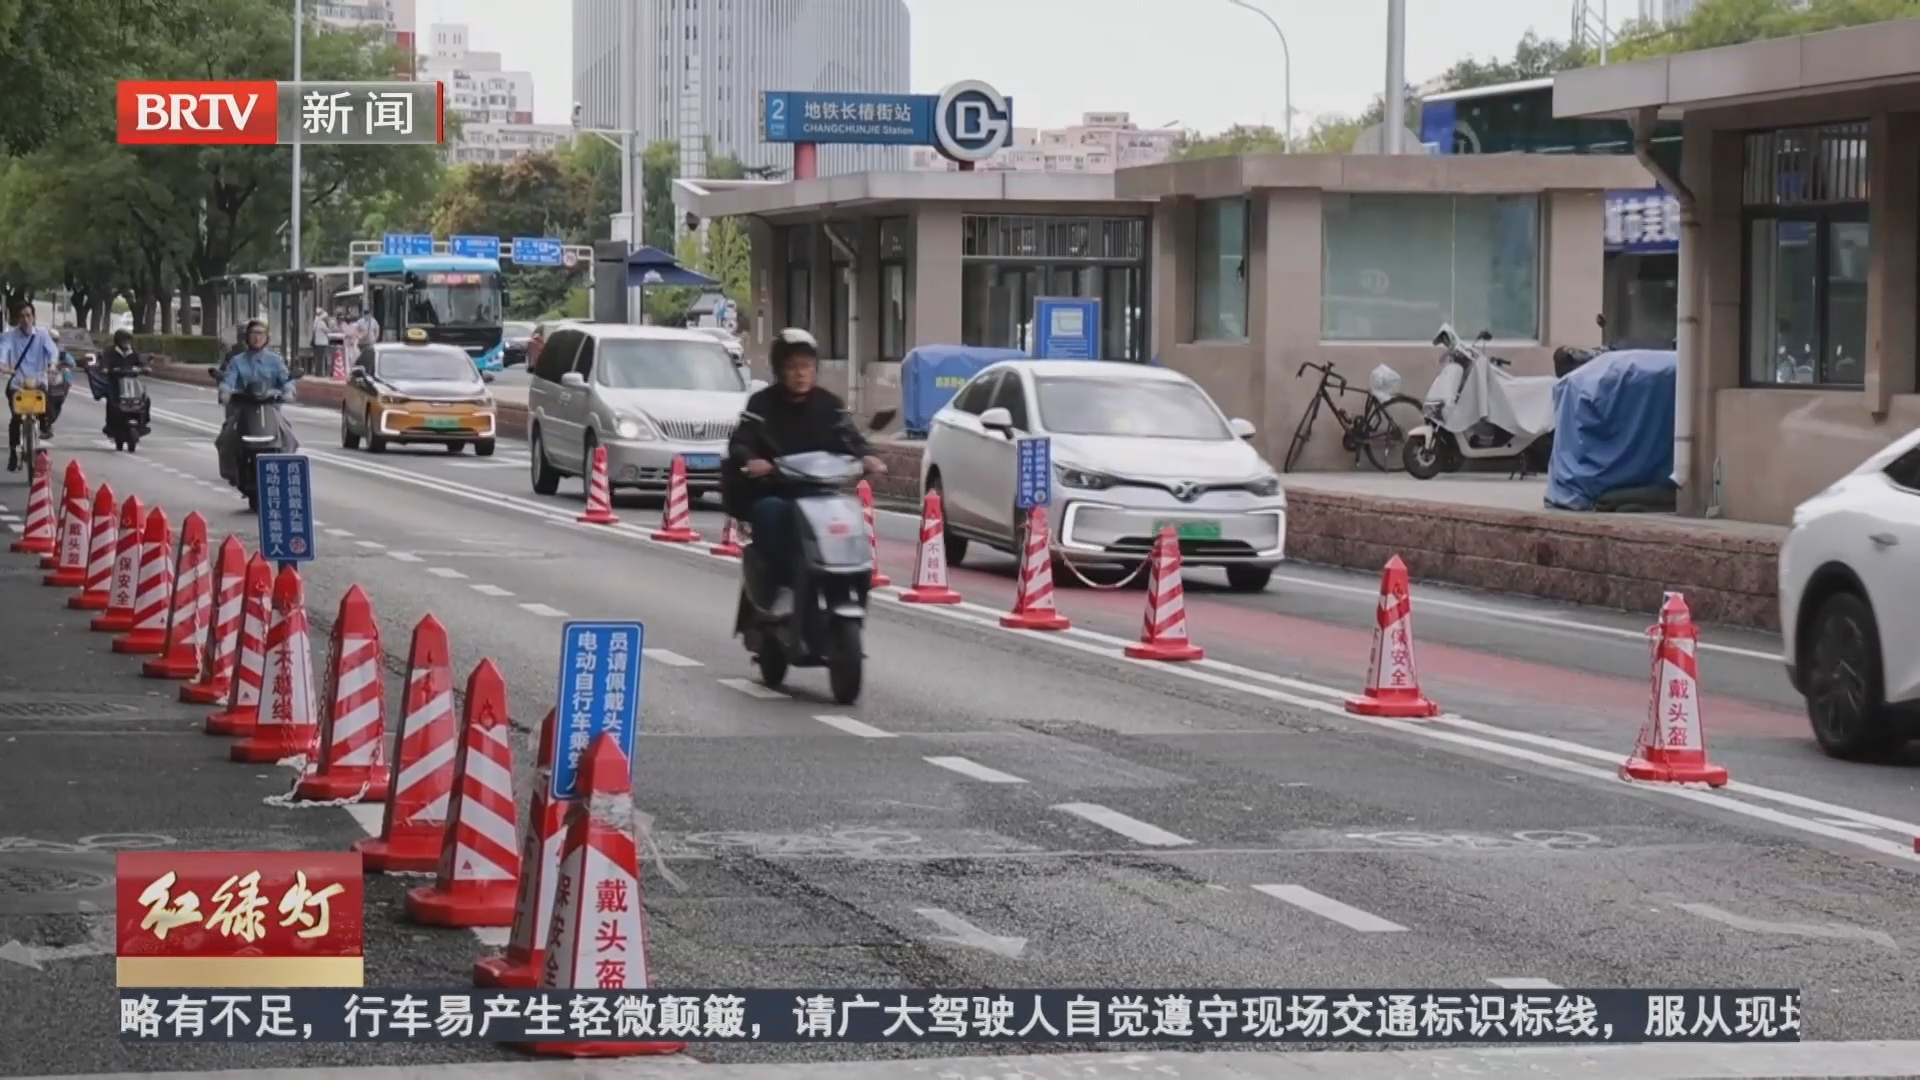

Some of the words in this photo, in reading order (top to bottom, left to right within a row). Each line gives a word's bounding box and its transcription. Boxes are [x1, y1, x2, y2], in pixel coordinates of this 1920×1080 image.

[772, 99, 785, 120] 2
[803, 123, 879, 134] CHANGCHUNJIE
[882, 125, 914, 135] Station
[804, 101, 912, 122] 地铁长椿街站
[116, 556, 132, 606] 保安全
[272, 651, 293, 721] 不越线
[602, 632, 628, 745] 员请佩戴头
[1391, 629, 1408, 686] 保安全
[566, 631, 598, 790] 电动自行车乘驾
[1667, 678, 1689, 746] 戴头盔
[595, 879, 628, 988] 戴头盔
